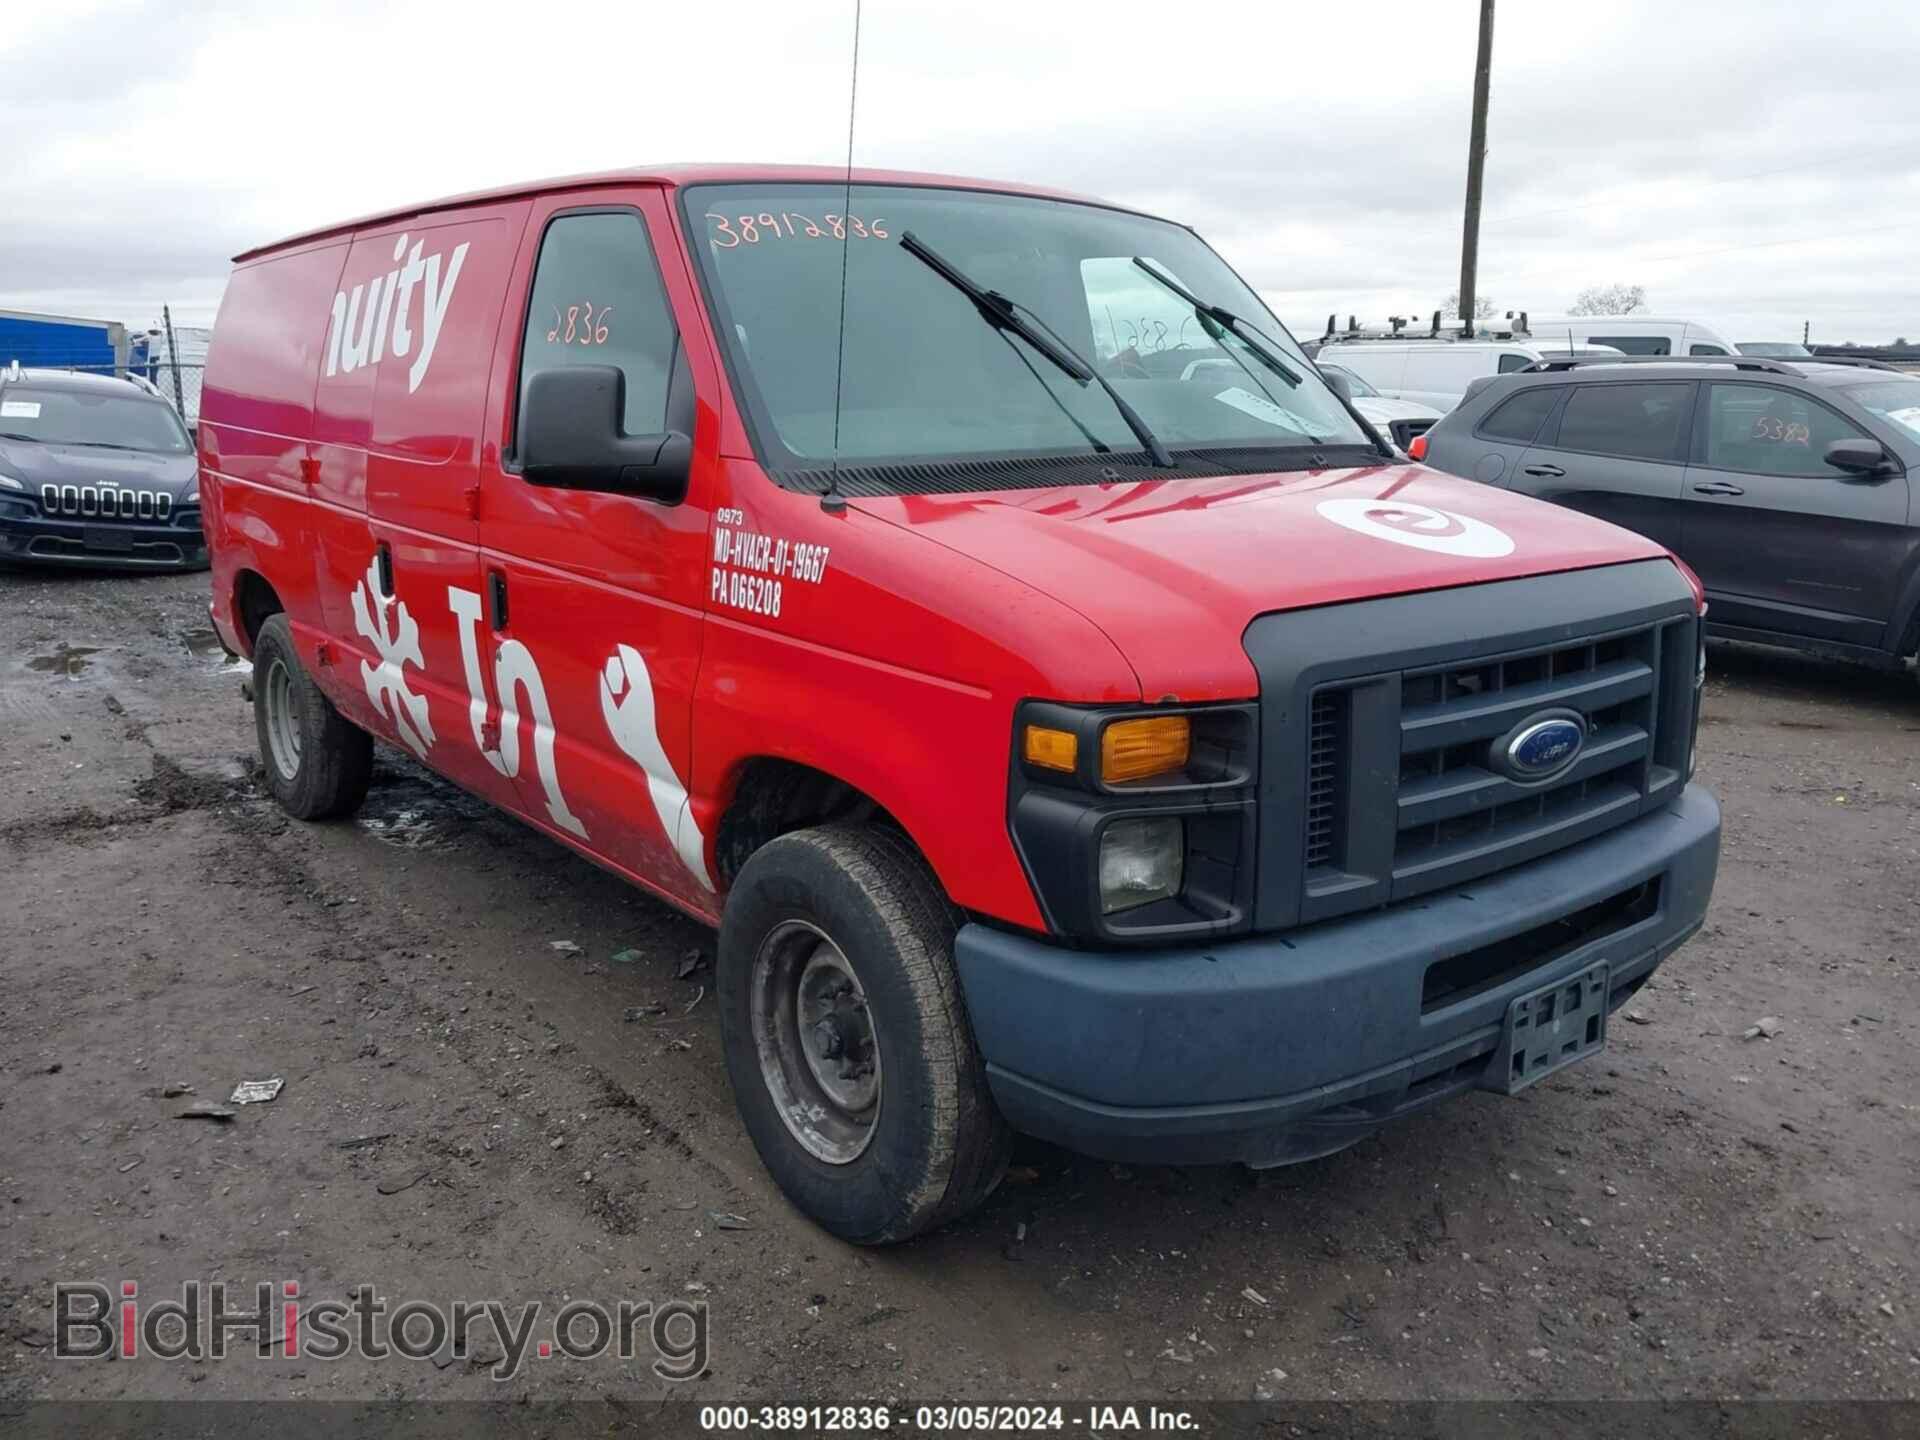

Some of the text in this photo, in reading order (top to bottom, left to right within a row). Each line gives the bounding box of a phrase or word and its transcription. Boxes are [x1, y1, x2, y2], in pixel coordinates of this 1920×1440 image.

[705, 212, 889, 248] 38912836
[546, 302, 612, 344] 2836
[717, 507, 743, 526] 0973
[714, 527, 830, 584] MD-HVACR-01-19667
[712, 567, 782, 618] PA 066208
